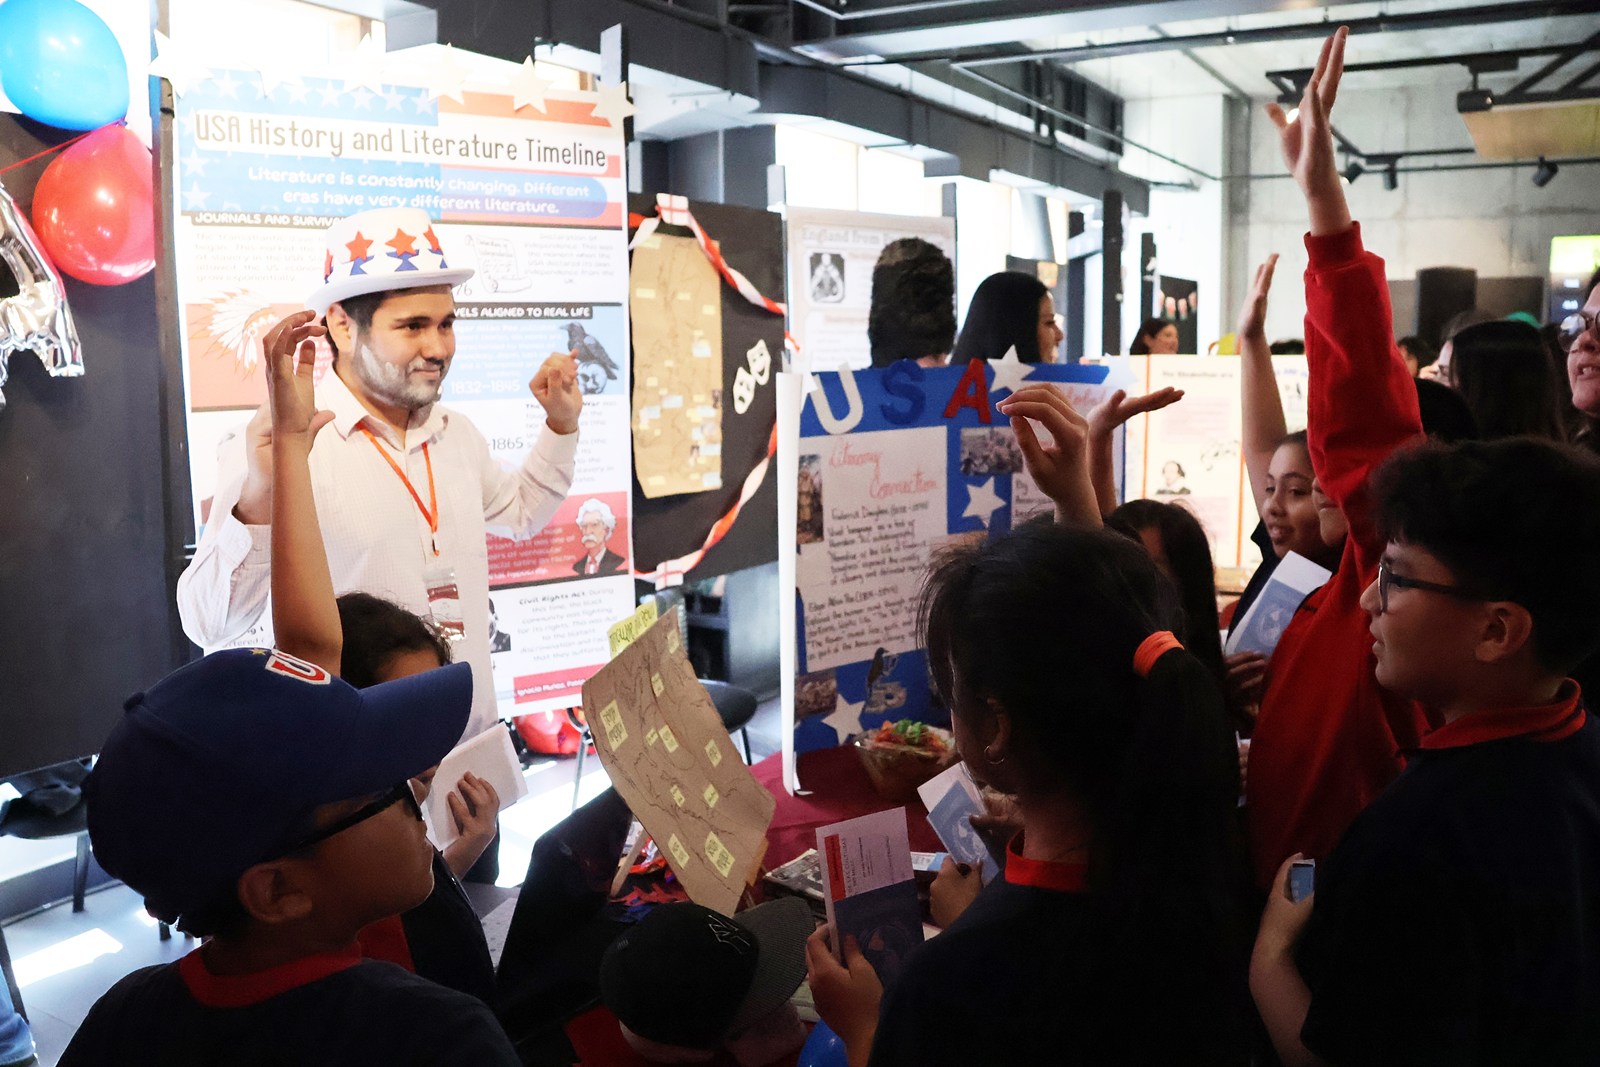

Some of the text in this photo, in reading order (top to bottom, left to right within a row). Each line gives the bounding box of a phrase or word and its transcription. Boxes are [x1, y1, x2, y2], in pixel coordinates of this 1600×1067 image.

[195, 113, 606, 167] USA History and Literature Timeline
[248, 167, 589, 197] Literature is constantly changing. Different
[283, 190, 560, 214] eras have very different literature.
[195, 212, 262, 224] JOURNALS
[264, 214, 290, 225] AND
[457, 284, 472, 297] 76
[453, 306, 590, 318] VELS ALIGNED TO REAL LIFE
[809, 358, 992, 435] USA
[519, 597, 539, 605] Civil
[542, 594, 569, 603] Rights
